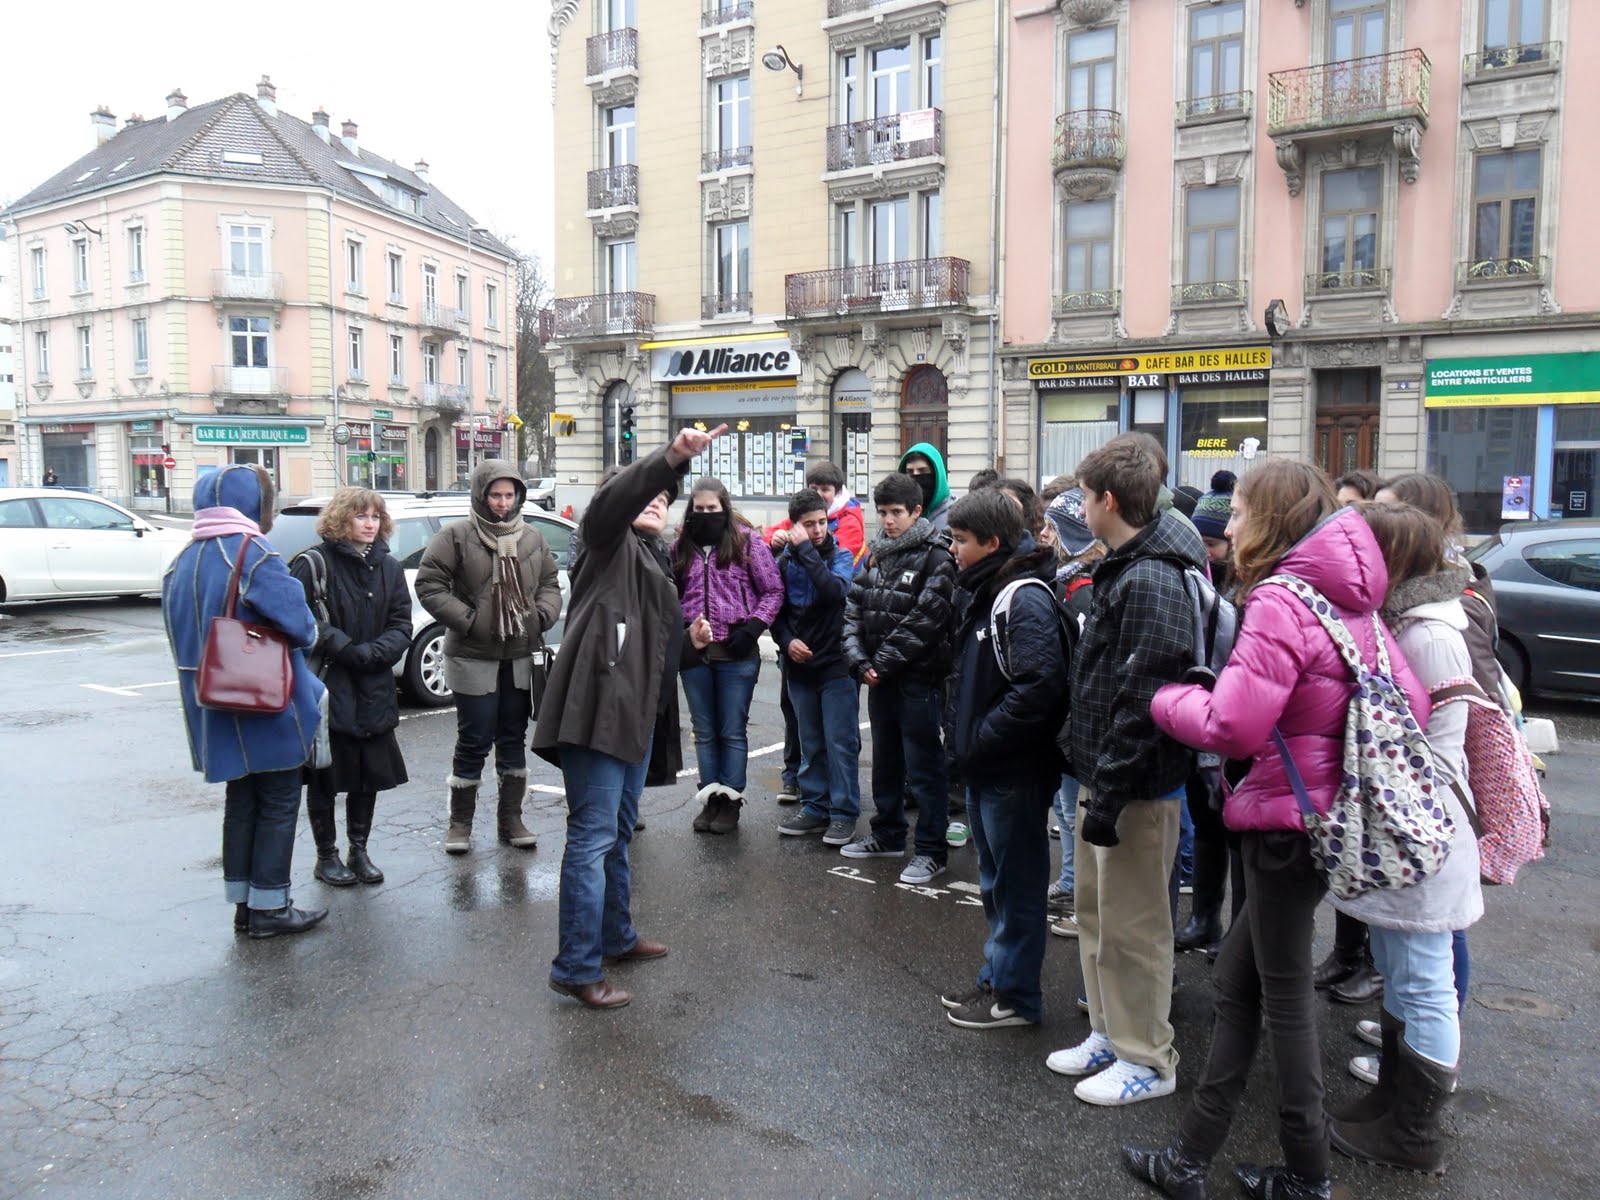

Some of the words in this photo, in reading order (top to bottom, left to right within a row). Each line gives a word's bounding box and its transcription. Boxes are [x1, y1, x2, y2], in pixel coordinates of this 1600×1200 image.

[693, 347, 790, 374] Alliance
[1145, 358, 1170, 369] CAFE
[1175, 356, 1194, 368] BAR
[1200, 355, 1220, 366] DES
[1225, 352, 1266, 365] HALLES
[1032, 363, 1067, 374] GOLD
[1431, 369, 1481, 378] LOCATIONS
[1483, 368, 1495, 376] ET
[1496, 367, 1532, 375] VENTES
[1039, 380, 1056, 388] BAR
[1060, 379, 1075, 387] DES
[1080, 377, 1113, 386] HALLES
[1128, 375, 1159, 387] BAR
[1180, 374, 1199, 384] BAR
[1202, 373, 1221, 382] DES
[1225, 370, 1264, 381] HALLES
[1431, 378, 1462, 386] ENTRE
[1464, 375, 1532, 385] PARTICULIERS
[675, 385, 711, 393] transaction
[197, 429, 213, 439] BAR
[216, 429, 226, 439] DE
[229, 430, 239, 440] LA
[241, 429, 288, 441] REPUBLIQUE
[1196, 438, 1228, 448] BIERE
[1188, 449, 1235, 459] PRESSION
